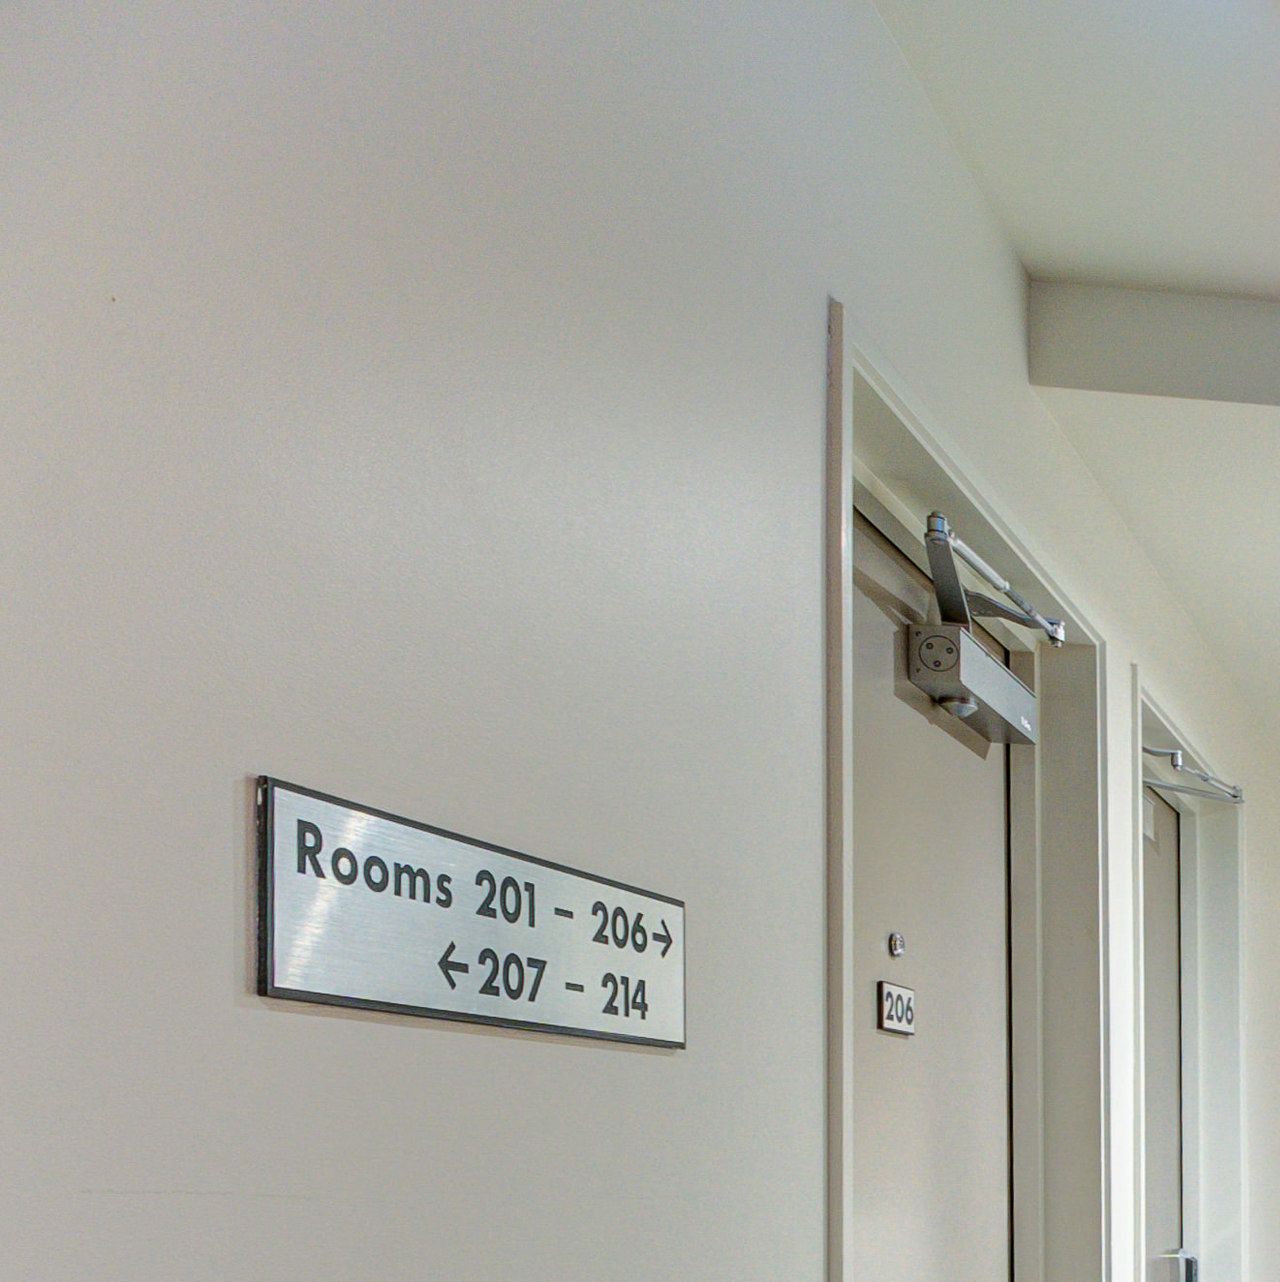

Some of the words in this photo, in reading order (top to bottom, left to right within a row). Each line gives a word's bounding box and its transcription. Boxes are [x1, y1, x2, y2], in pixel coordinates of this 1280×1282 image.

[296, 818, 453, 909] Rooms
[475, 869, 535, 928] 201
[591, 900, 648, 954] 206
[478, 947, 548, 1002] 207
[601, 972, 649, 1020] 214
[885, 991, 914, 1026] 206
